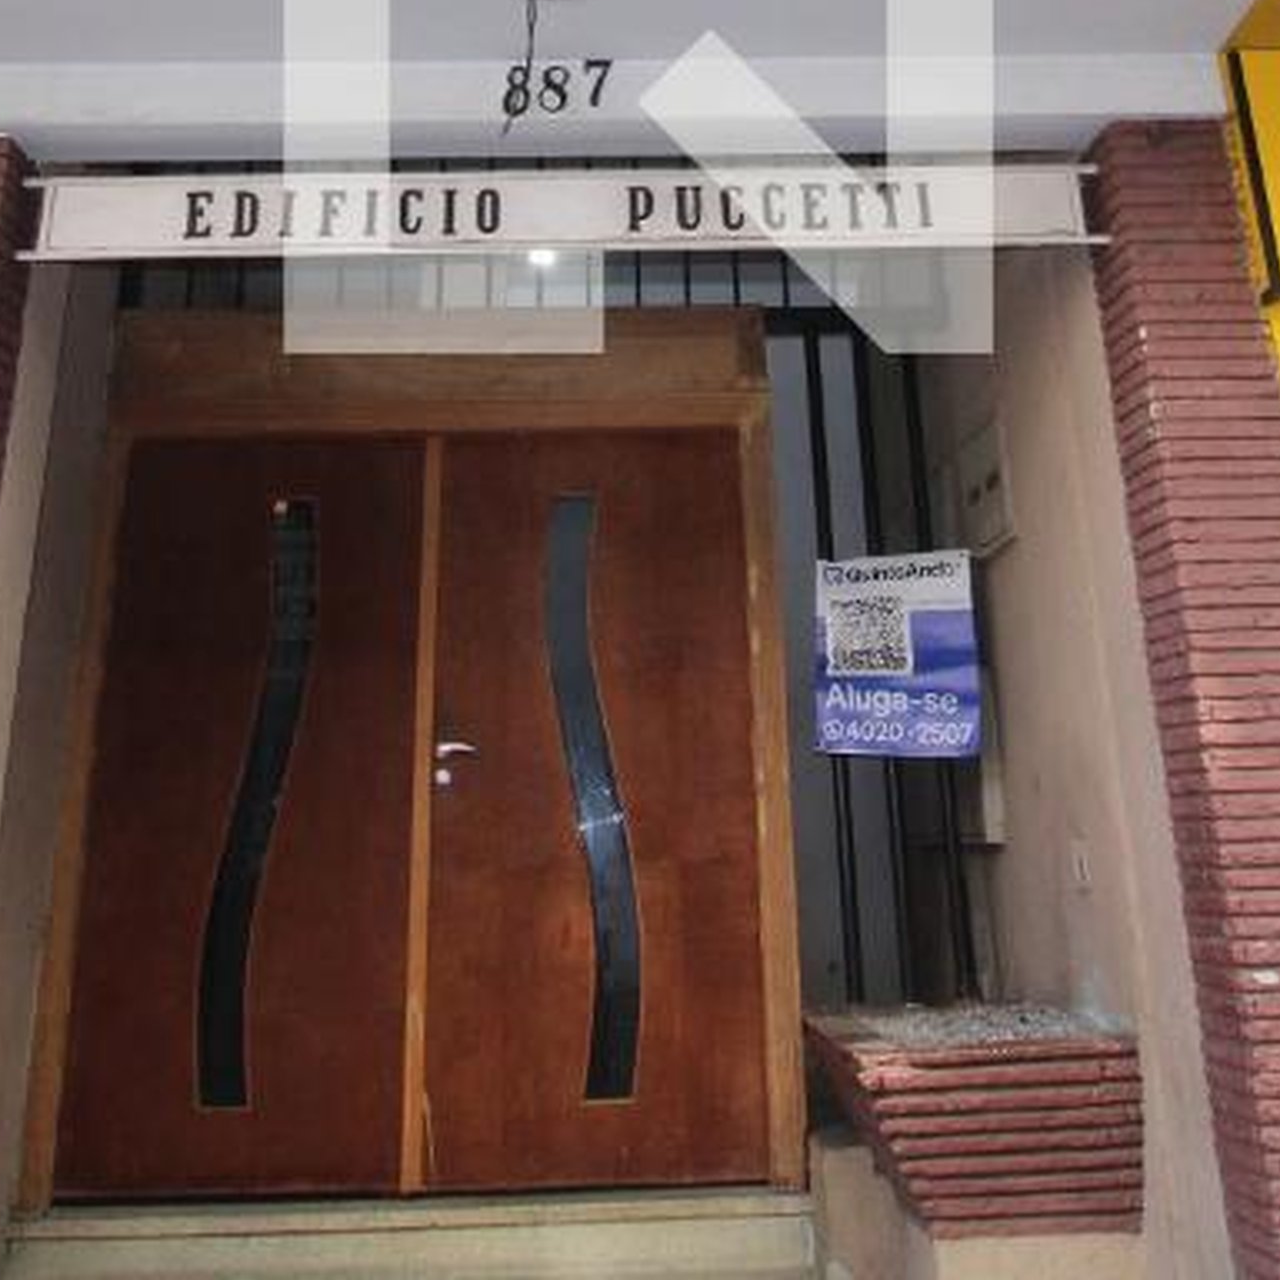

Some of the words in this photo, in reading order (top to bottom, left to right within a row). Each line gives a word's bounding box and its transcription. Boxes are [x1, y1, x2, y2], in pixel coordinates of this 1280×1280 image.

[503, 59, 613, 117] 887
[183, 188, 501, 239] EDIFICIO
[626, 181, 936, 233] PUCCETTI
[826, 682, 959, 718] Aluga-se
